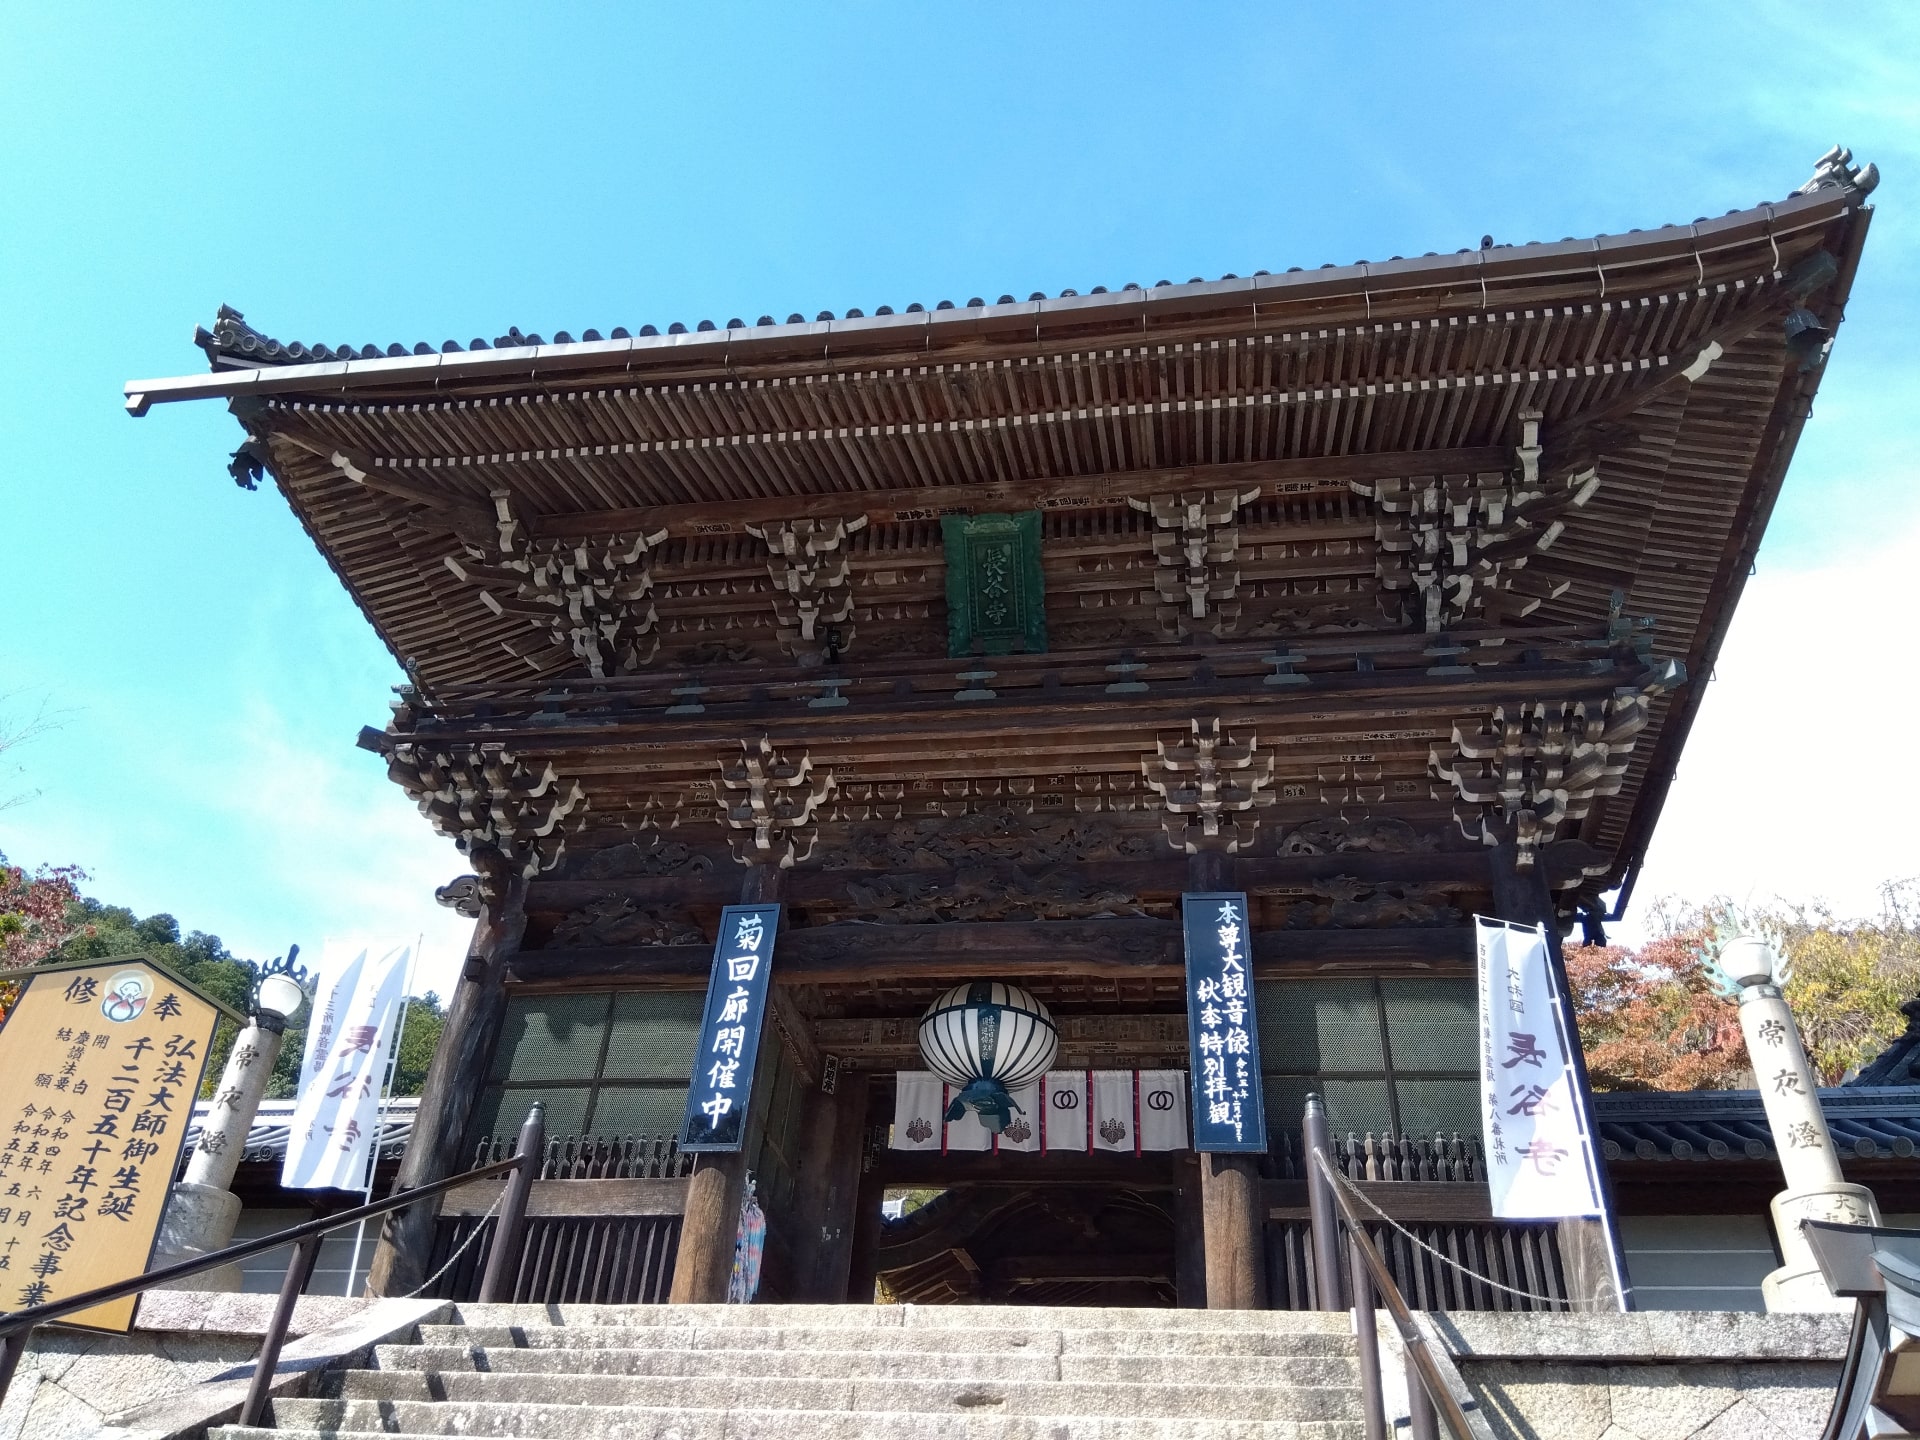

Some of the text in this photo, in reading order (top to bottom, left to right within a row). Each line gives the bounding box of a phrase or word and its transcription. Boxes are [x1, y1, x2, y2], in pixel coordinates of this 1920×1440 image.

[982, 548, 1009, 625] 長谷寺
[701, 913, 764, 1130] 菊回廊開催中
[1197, 977, 1235, 1125] 秋季特別拝観
[1215, 901, 1250, 1054] 本尊大観音像
[18, 1037, 155, 1308] 千二百五十年記念事業
[97, 1034, 196, 1222] 弘法大師御生誕
